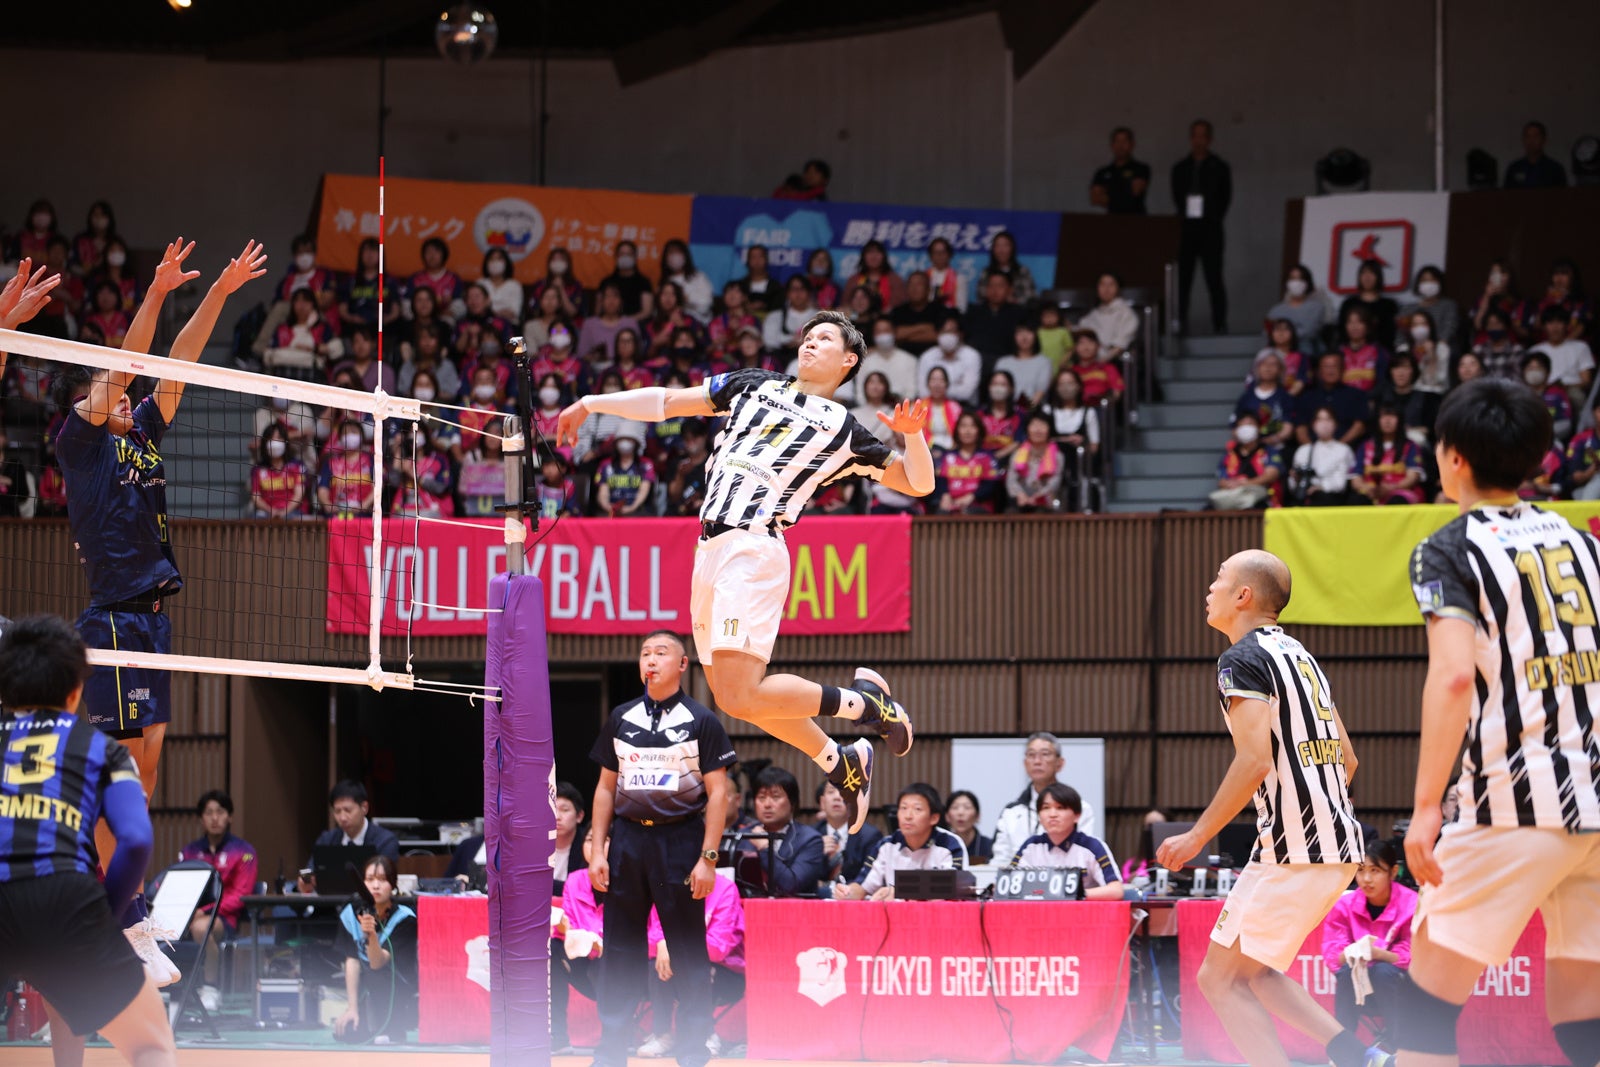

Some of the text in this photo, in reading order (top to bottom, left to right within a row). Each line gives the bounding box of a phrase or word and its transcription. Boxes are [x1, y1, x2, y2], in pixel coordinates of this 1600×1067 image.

[743, 227, 791, 246] FAIR
[740, 247, 803, 267] IDE
[757, 393, 832, 432] Panasonic
[1515, 544, 1596, 632] 15
[724, 618, 739, 636] 11
[1297, 660, 1332, 721] 2
[128, 702, 138, 720] 16
[629, 774, 656, 786] ANA
[1049, 873, 1078, 895] 05
[1216, 909, 1229, 930] 2
[857, 956, 1080, 997] TOKYO GREATBEARS
